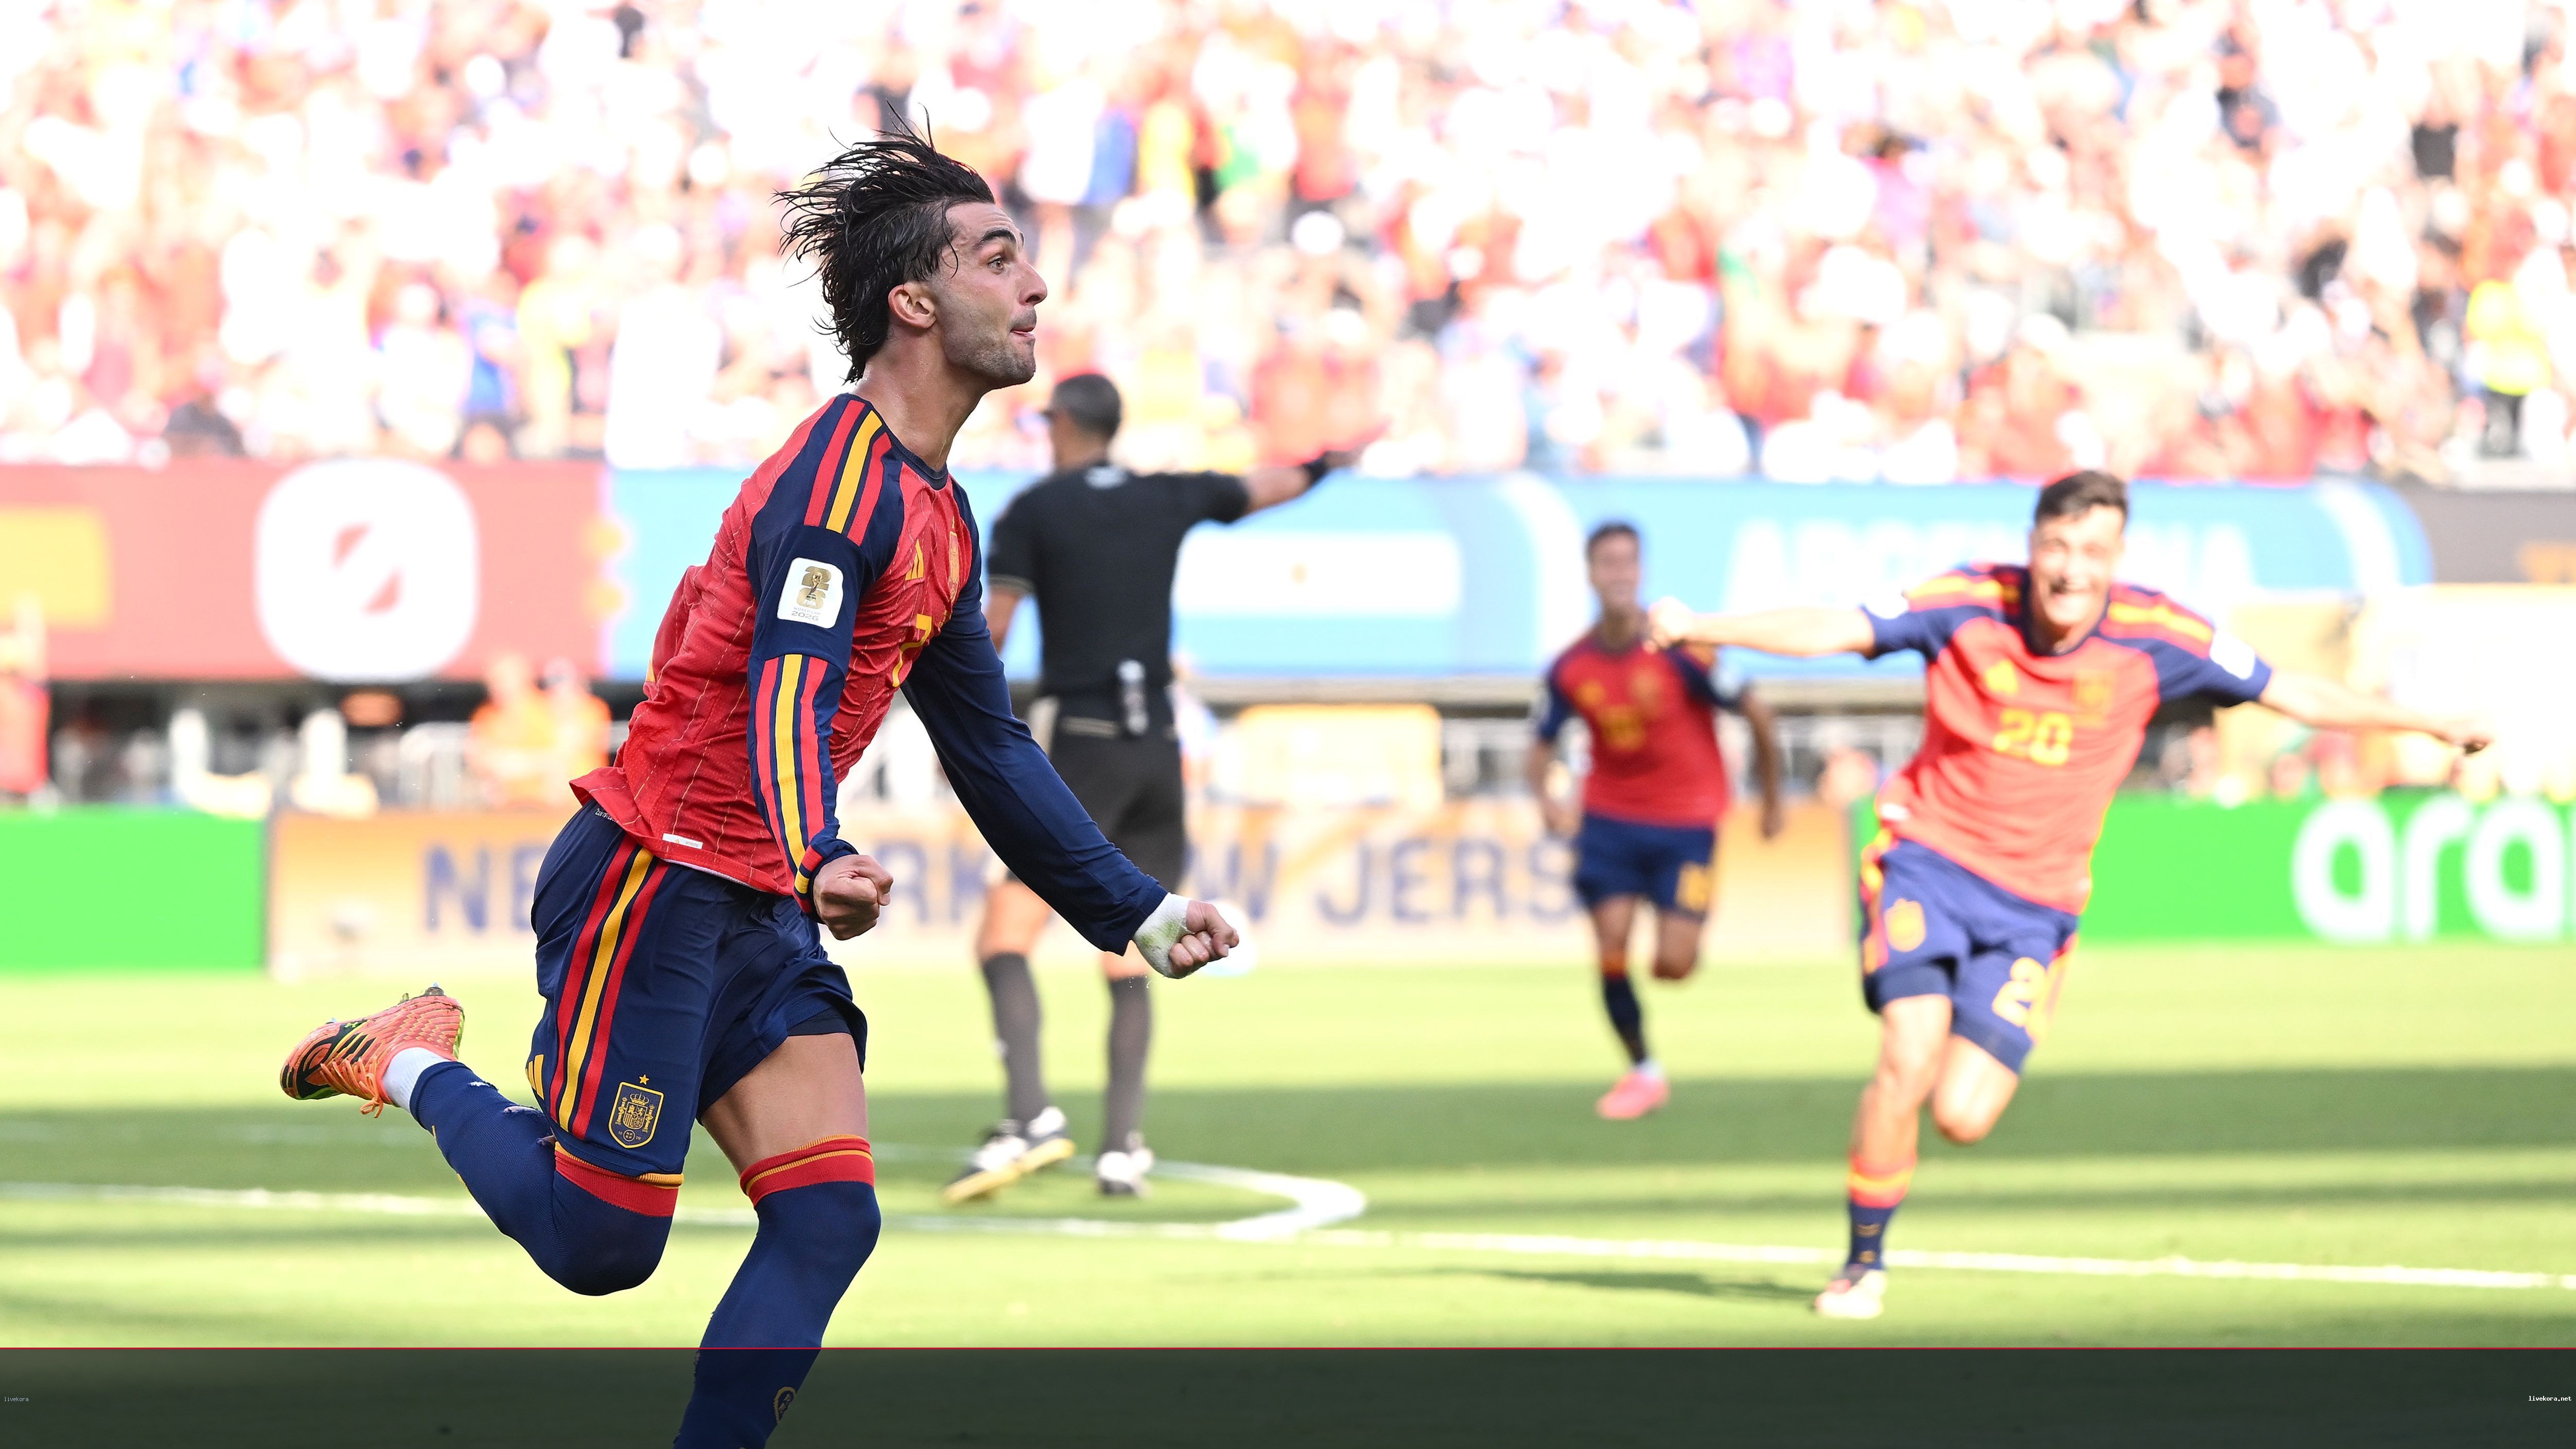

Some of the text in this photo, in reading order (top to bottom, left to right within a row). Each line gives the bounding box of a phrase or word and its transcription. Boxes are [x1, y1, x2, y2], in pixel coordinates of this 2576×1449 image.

[791, 610, 819, 621] 2026
[892, 614, 932, 688] 7
[1991, 707, 2073, 766] 20
[1317, 835, 1580, 927] JERS
[2293, 795, 2576, 942] ara
